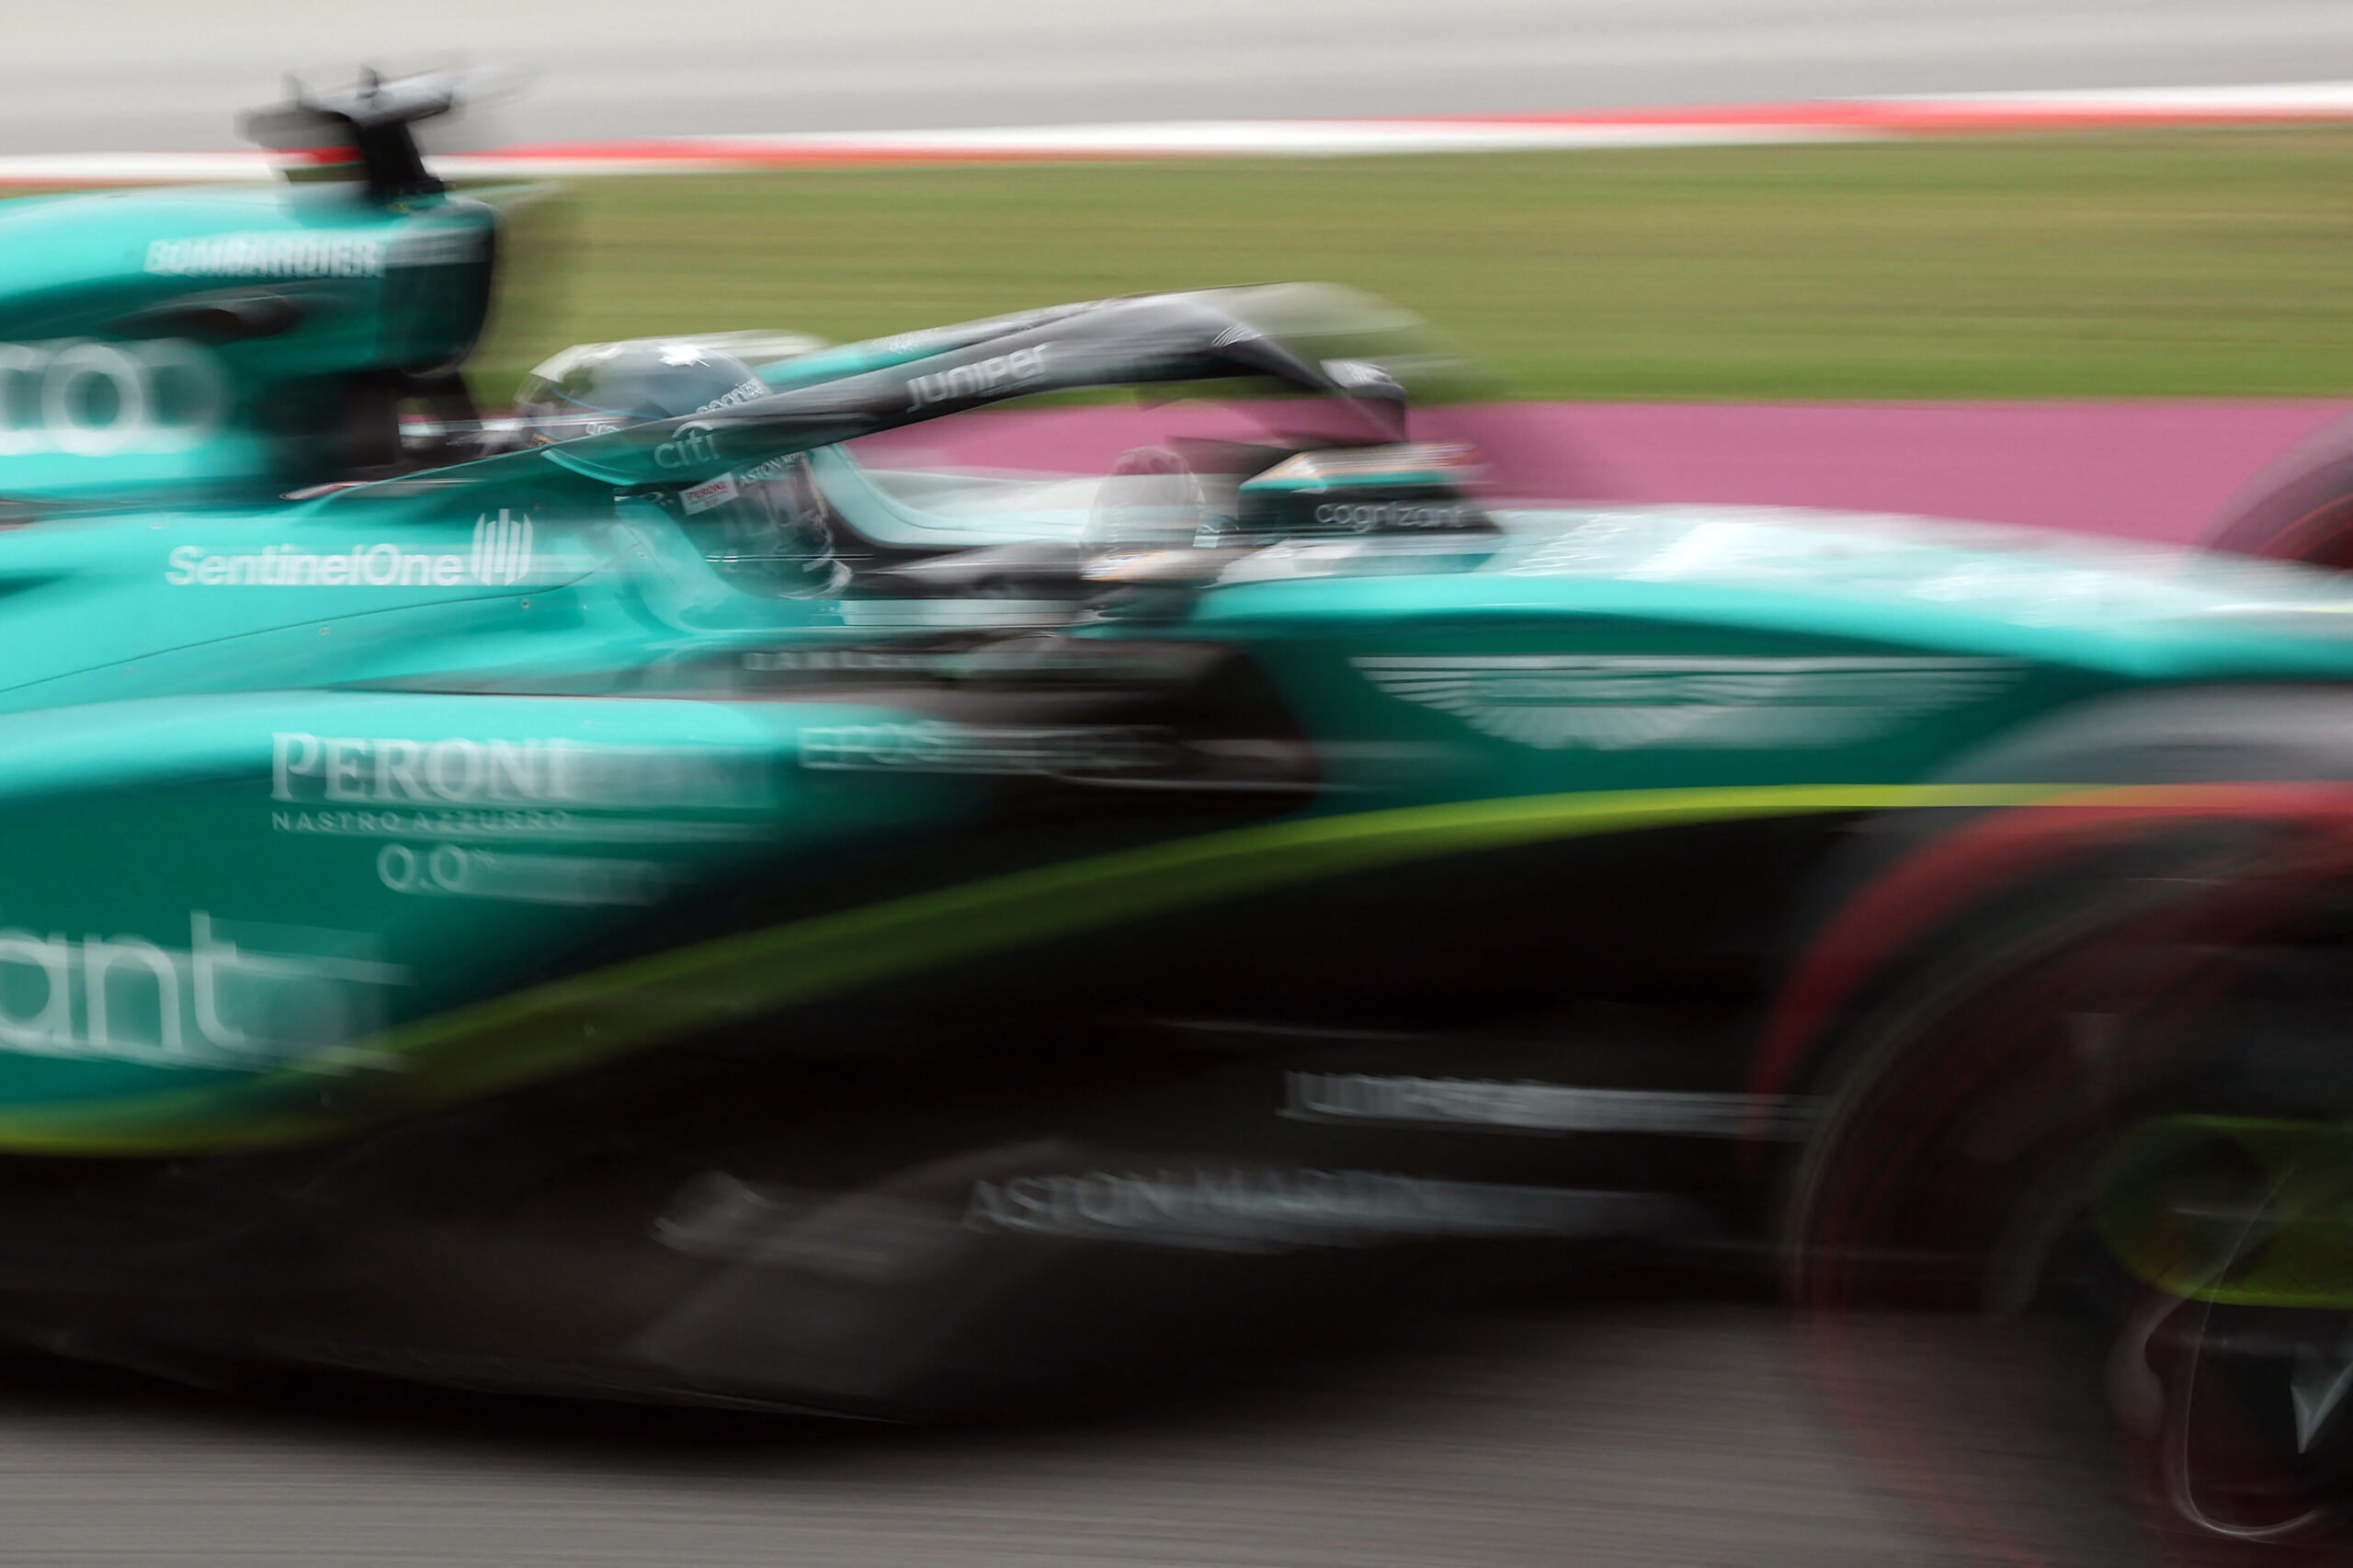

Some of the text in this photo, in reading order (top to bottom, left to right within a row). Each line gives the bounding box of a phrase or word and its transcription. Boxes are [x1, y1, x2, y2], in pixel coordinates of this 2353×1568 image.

[654, 423, 720, 469] citi
[1315, 503, 1465, 534] cognizant
[165, 543, 461, 586] SentinelOne
[270, 732, 574, 803] PERONI
[271, 811, 401, 833] NASTRO
